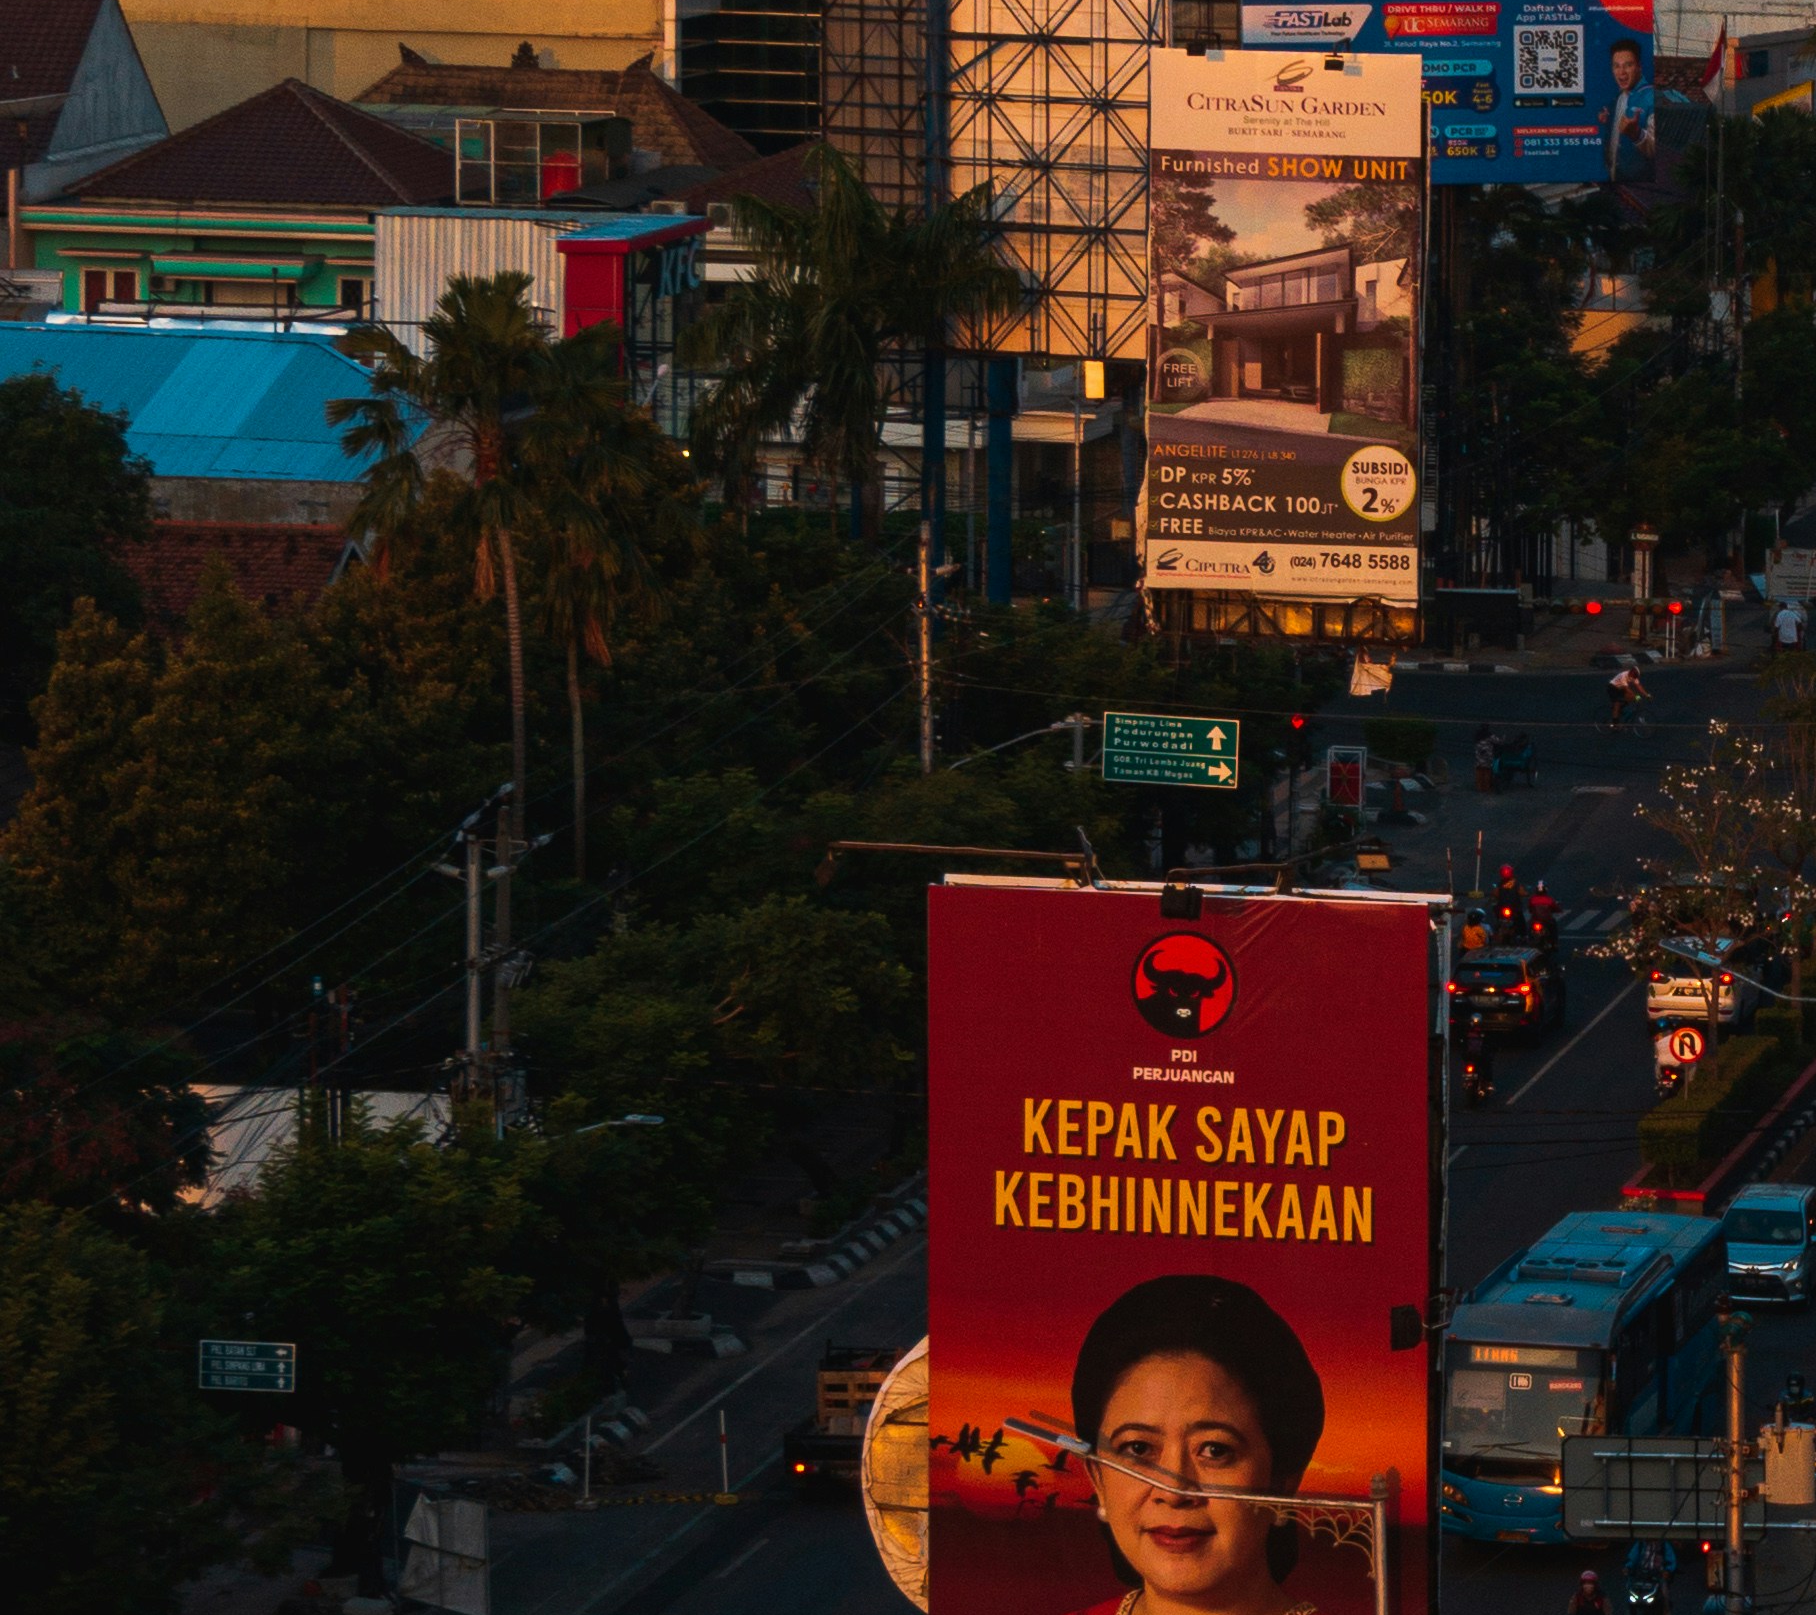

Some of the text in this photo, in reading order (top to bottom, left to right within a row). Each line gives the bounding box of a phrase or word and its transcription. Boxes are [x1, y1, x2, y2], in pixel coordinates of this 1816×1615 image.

[1387, 4, 1496, 14] DRIVE THRU WALK IN
[1523, 4, 1573, 13] Daftar Via
[1274, 11, 1352, 29] FASTLab
[1427, 16, 1489, 28] SEMARANG
[1516, 13, 1581, 22] App FASTLab
[1453, 62, 1477, 72] PCR
[1422, 90, 1457, 104] 50K
[1243, 115, 1330, 127] Serenity at The Hill
[1228, 127, 1346, 139] BUKIT SARI SEMARANG
[1524, 138, 1541, 146] 081
[1544, 138, 1560, 146] 333
[1563, 138, 1581, 146] 555
[1160, 155, 1408, 181] Furnished SHOW UNIT
[1163, 363, 1196, 374] FREE
[1167, 377, 1192, 387] LIFT
[1153, 444, 1227, 458] ANGELITE
[1352, 461, 1409, 475] SUBSIDI
[1160, 466, 1187, 483] DP
[1191, 473, 1216, 484] KPR
[1355, 476, 1406, 486] BUNGA KPR
[1160, 492, 1277, 513] CASHBACK
[1160, 517, 1203, 534] FREE
[1208, 526, 1236, 538] Biaya
[1185, 559, 1250, 574] CIPUTRA
[1289, 552, 1410, 570] (024) 7648 5588
[1114, 717, 1183, 728] Simpang Lima
[1113, 737, 1193, 750] Purwodadi
[1135, 756, 1147, 765] Tri
[1171, 1049, 1197, 1063] PDI
[1132, 1067, 1235, 1085] PERJUANGAN
[1023, 1097, 1346, 1167] KEPAK SAYAP
[994, 1170, 1373, 1243] KEBHINNEKAAN
